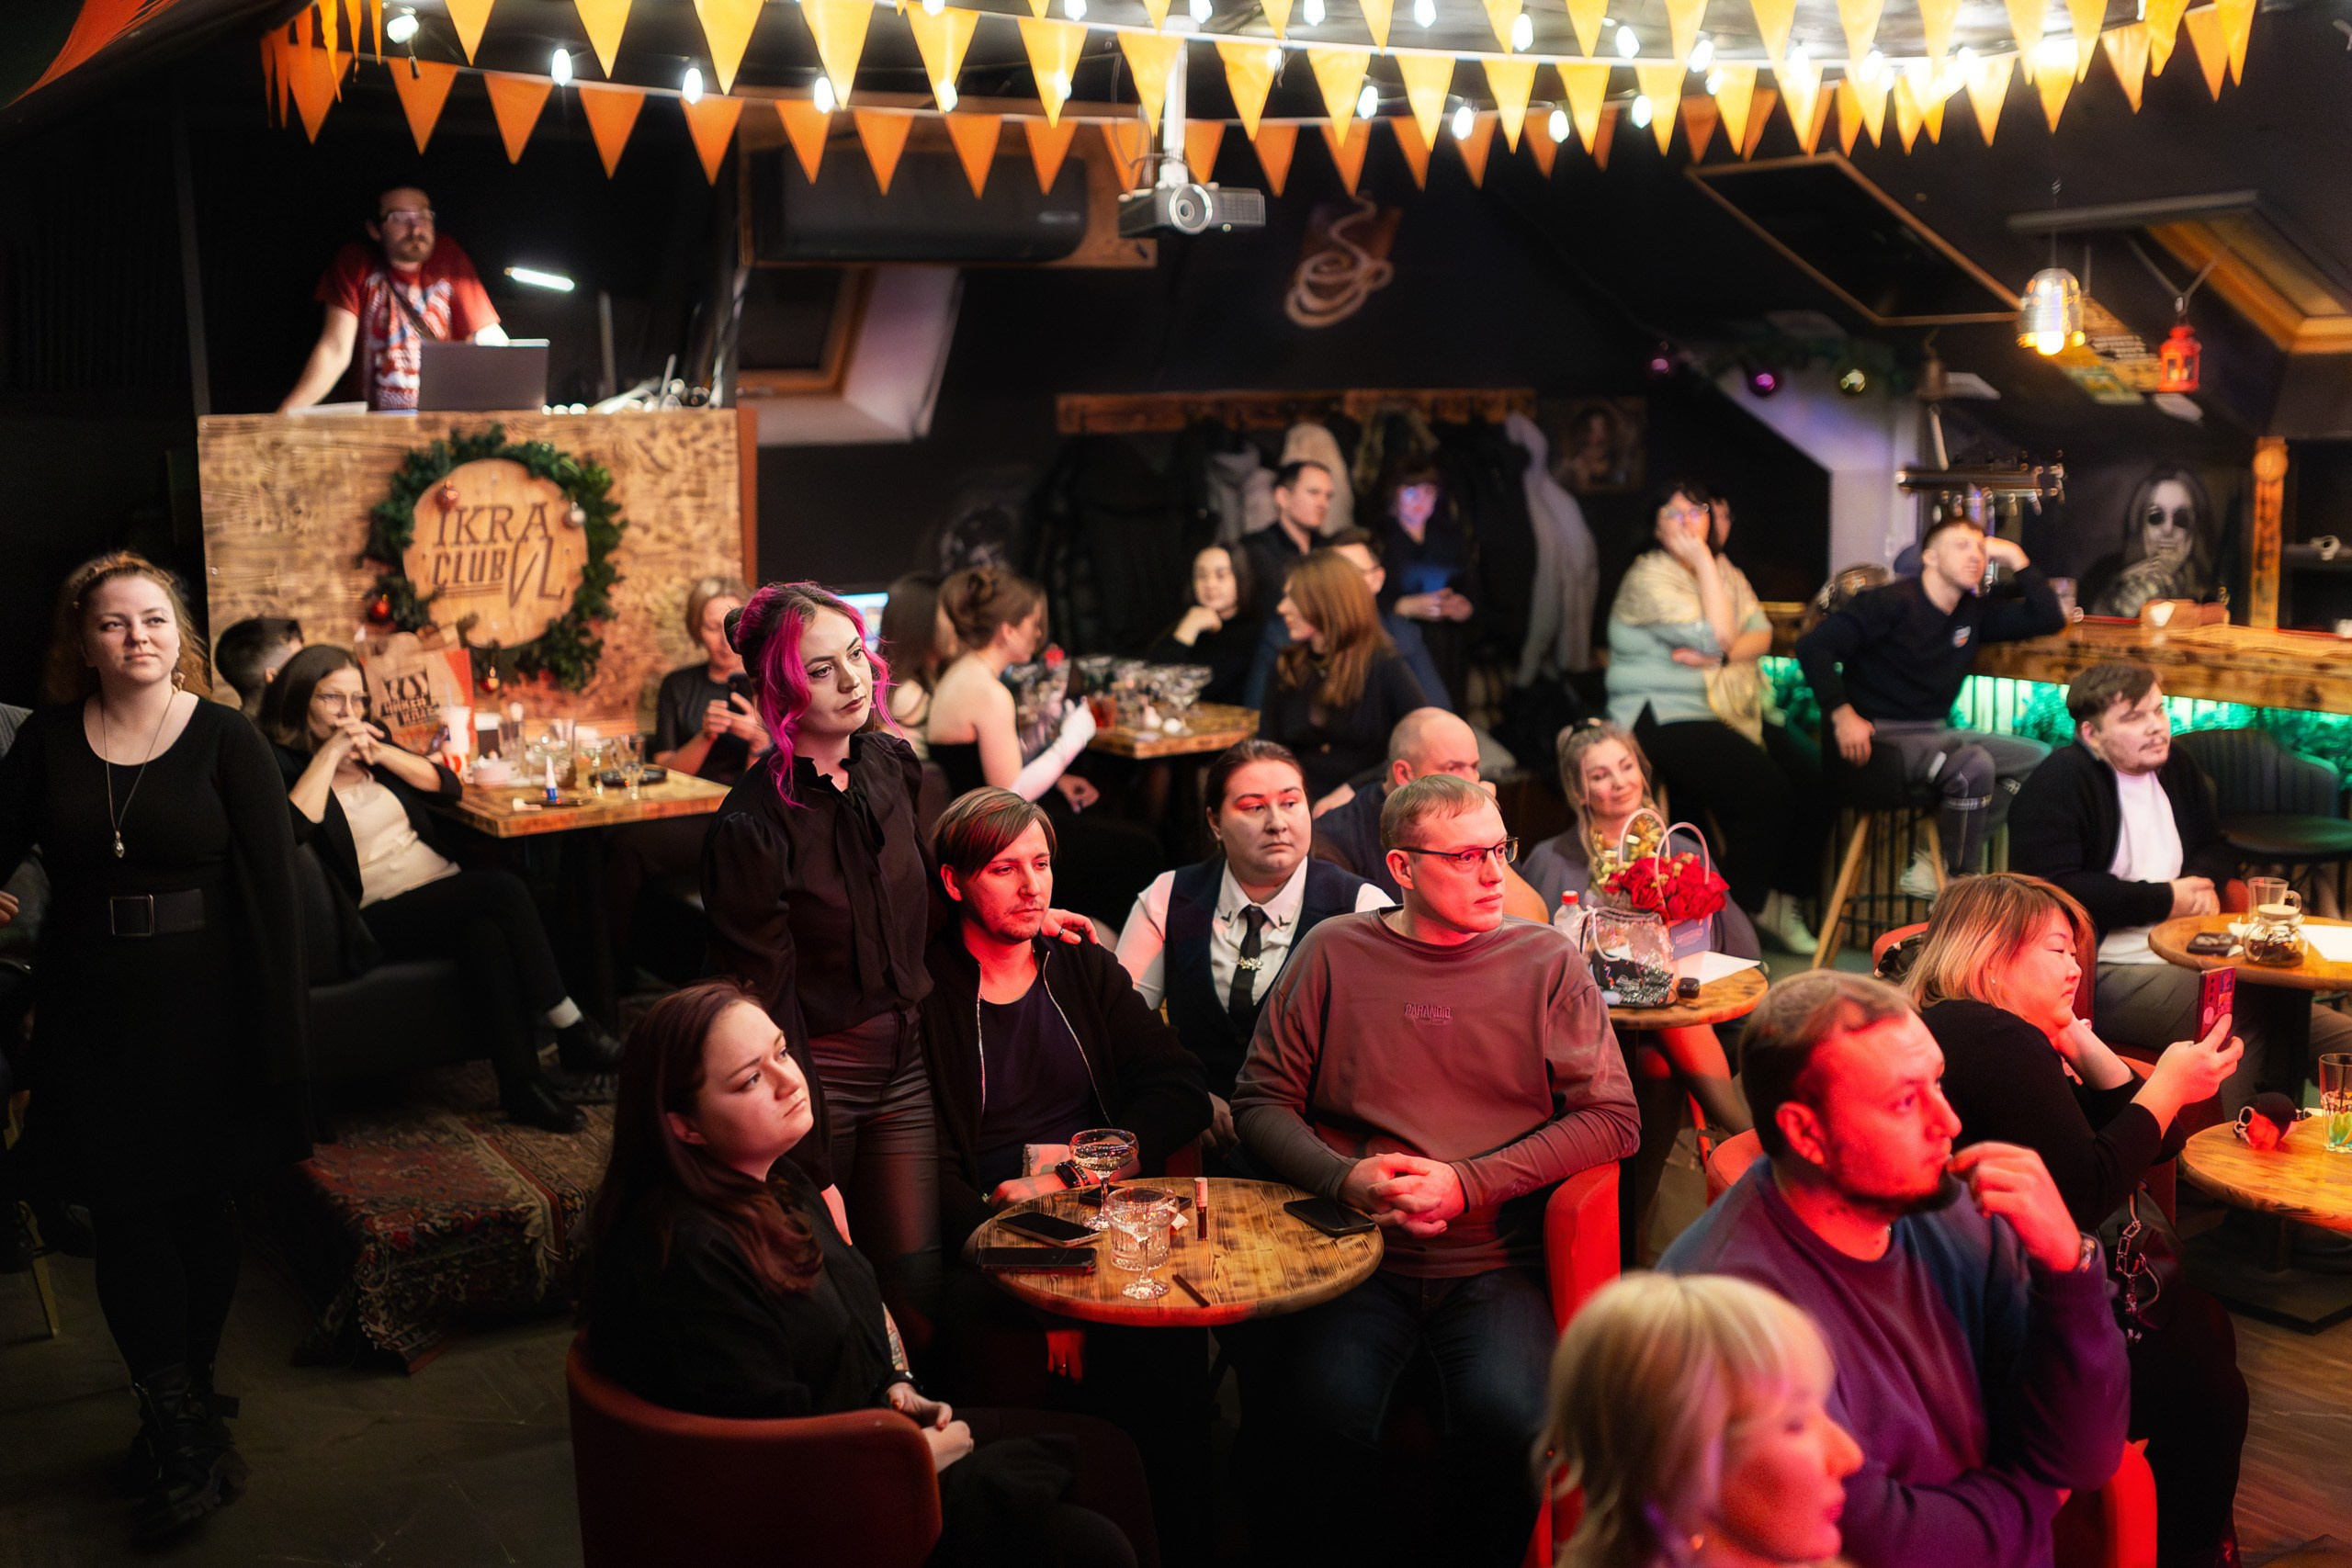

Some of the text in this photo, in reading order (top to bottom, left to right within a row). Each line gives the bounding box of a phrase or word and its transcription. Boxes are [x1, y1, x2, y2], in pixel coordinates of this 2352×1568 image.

[434, 502, 551, 547] IKRA
[432, 548, 506, 588] CLUB
[1404, 1002, 1452, 1019] PARANOID
